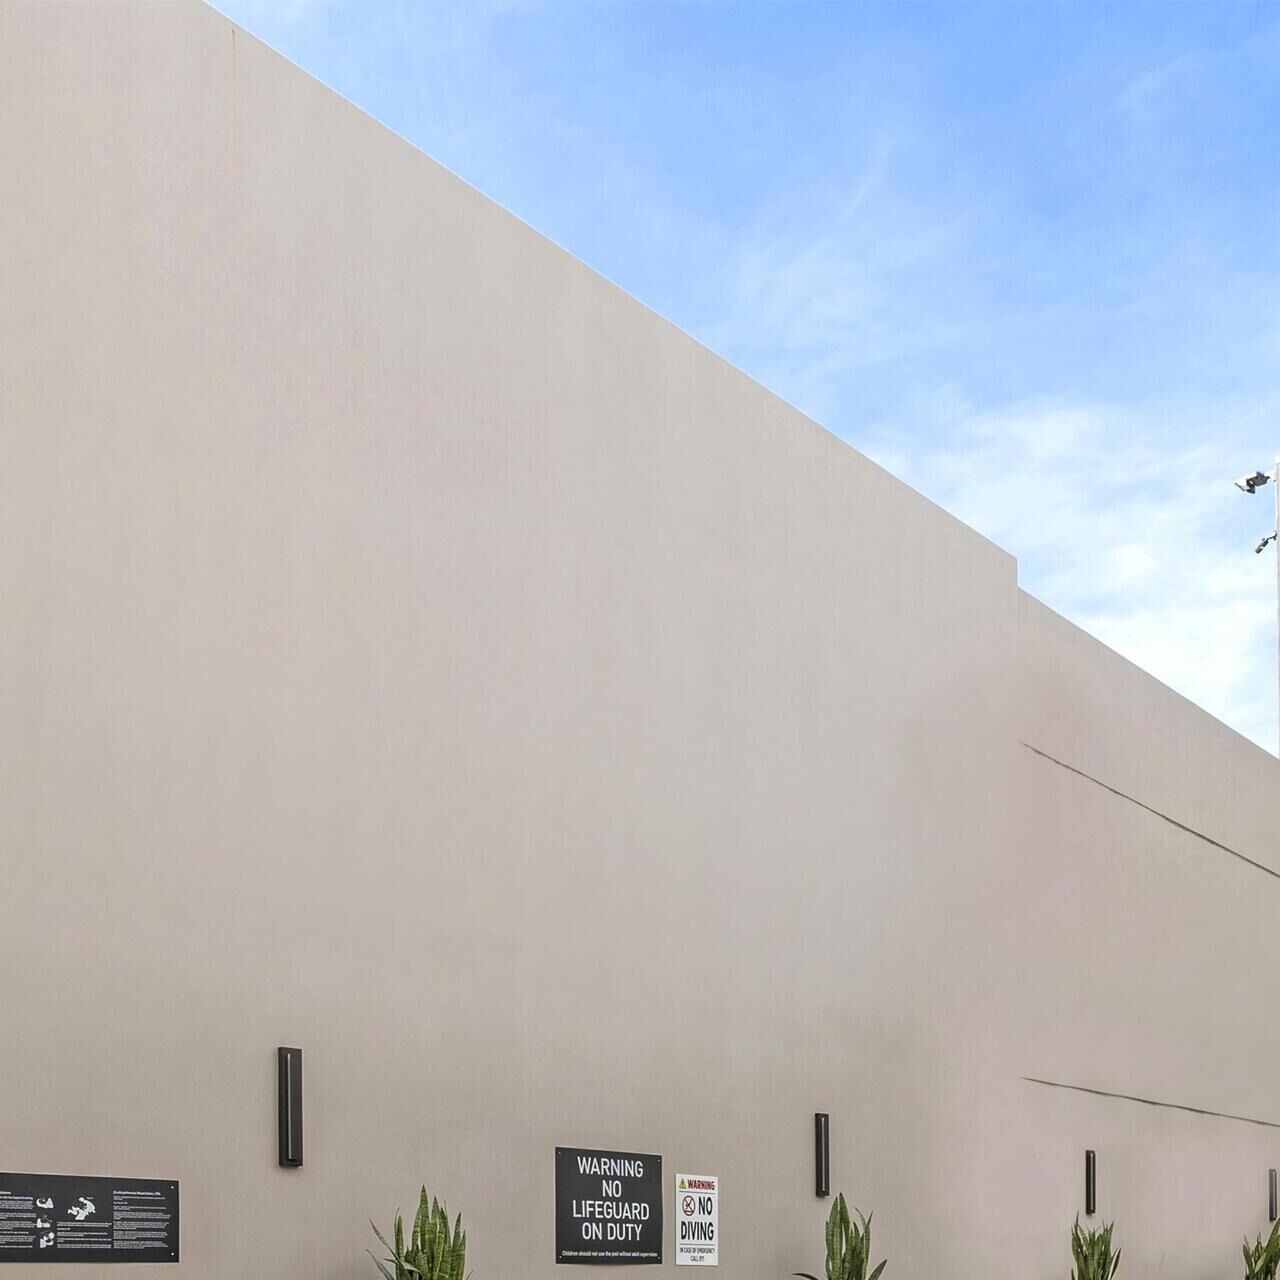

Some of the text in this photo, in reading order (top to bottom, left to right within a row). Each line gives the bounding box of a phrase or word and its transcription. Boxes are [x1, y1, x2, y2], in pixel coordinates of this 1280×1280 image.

[577, 1155, 644, 1178] WARNING
[602, 1179, 622, 1198] NO
[687, 1179, 715, 1191] WARNING
[572, 1199, 650, 1221] LIFEGUARD
[698, 1196, 713, 1216] NO
[582, 1222, 643, 1241] ON DUTY
[680, 1220, 714, 1241] DIVING
